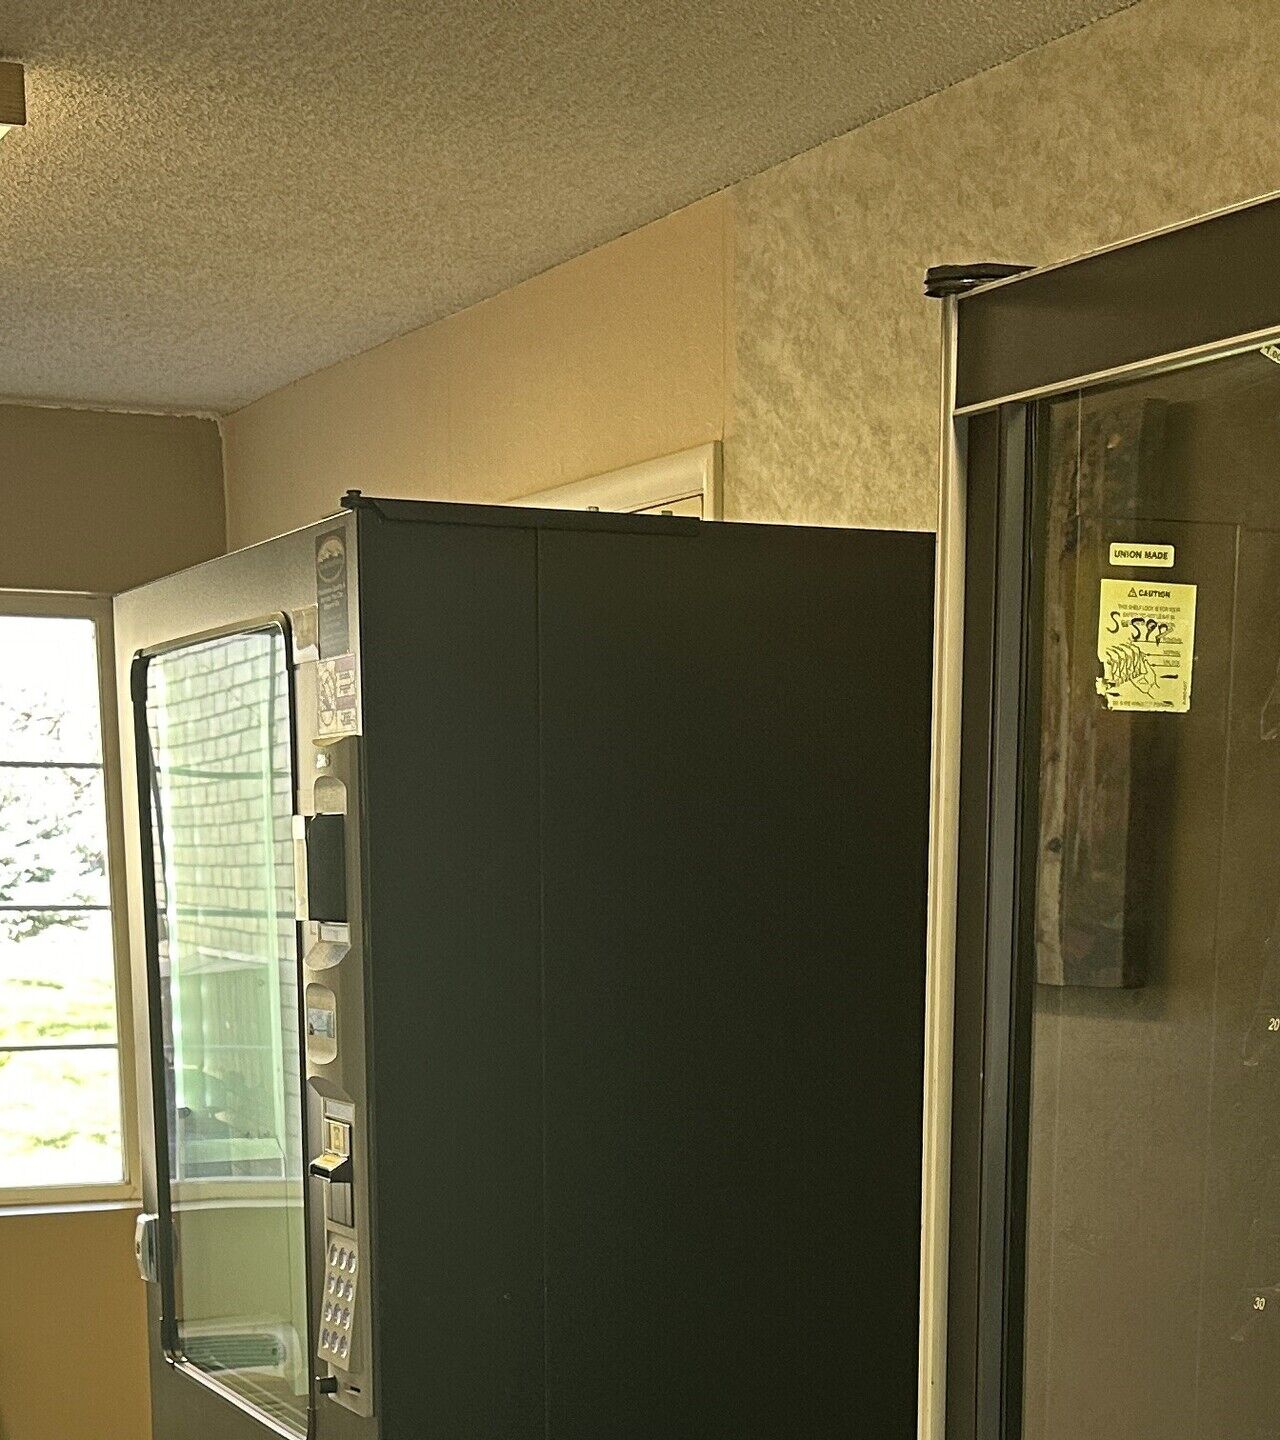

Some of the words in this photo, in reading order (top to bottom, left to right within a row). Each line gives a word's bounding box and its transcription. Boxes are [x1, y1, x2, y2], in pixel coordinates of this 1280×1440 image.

[1114, 549, 1142, 559] UNION
[1144, 550, 1169, 560] MADE
[1138, 588, 1171, 599] CAUTION
[1267, 1017, 1280, 1031] 20
[1253, 1296, 1266, 1311] 30
